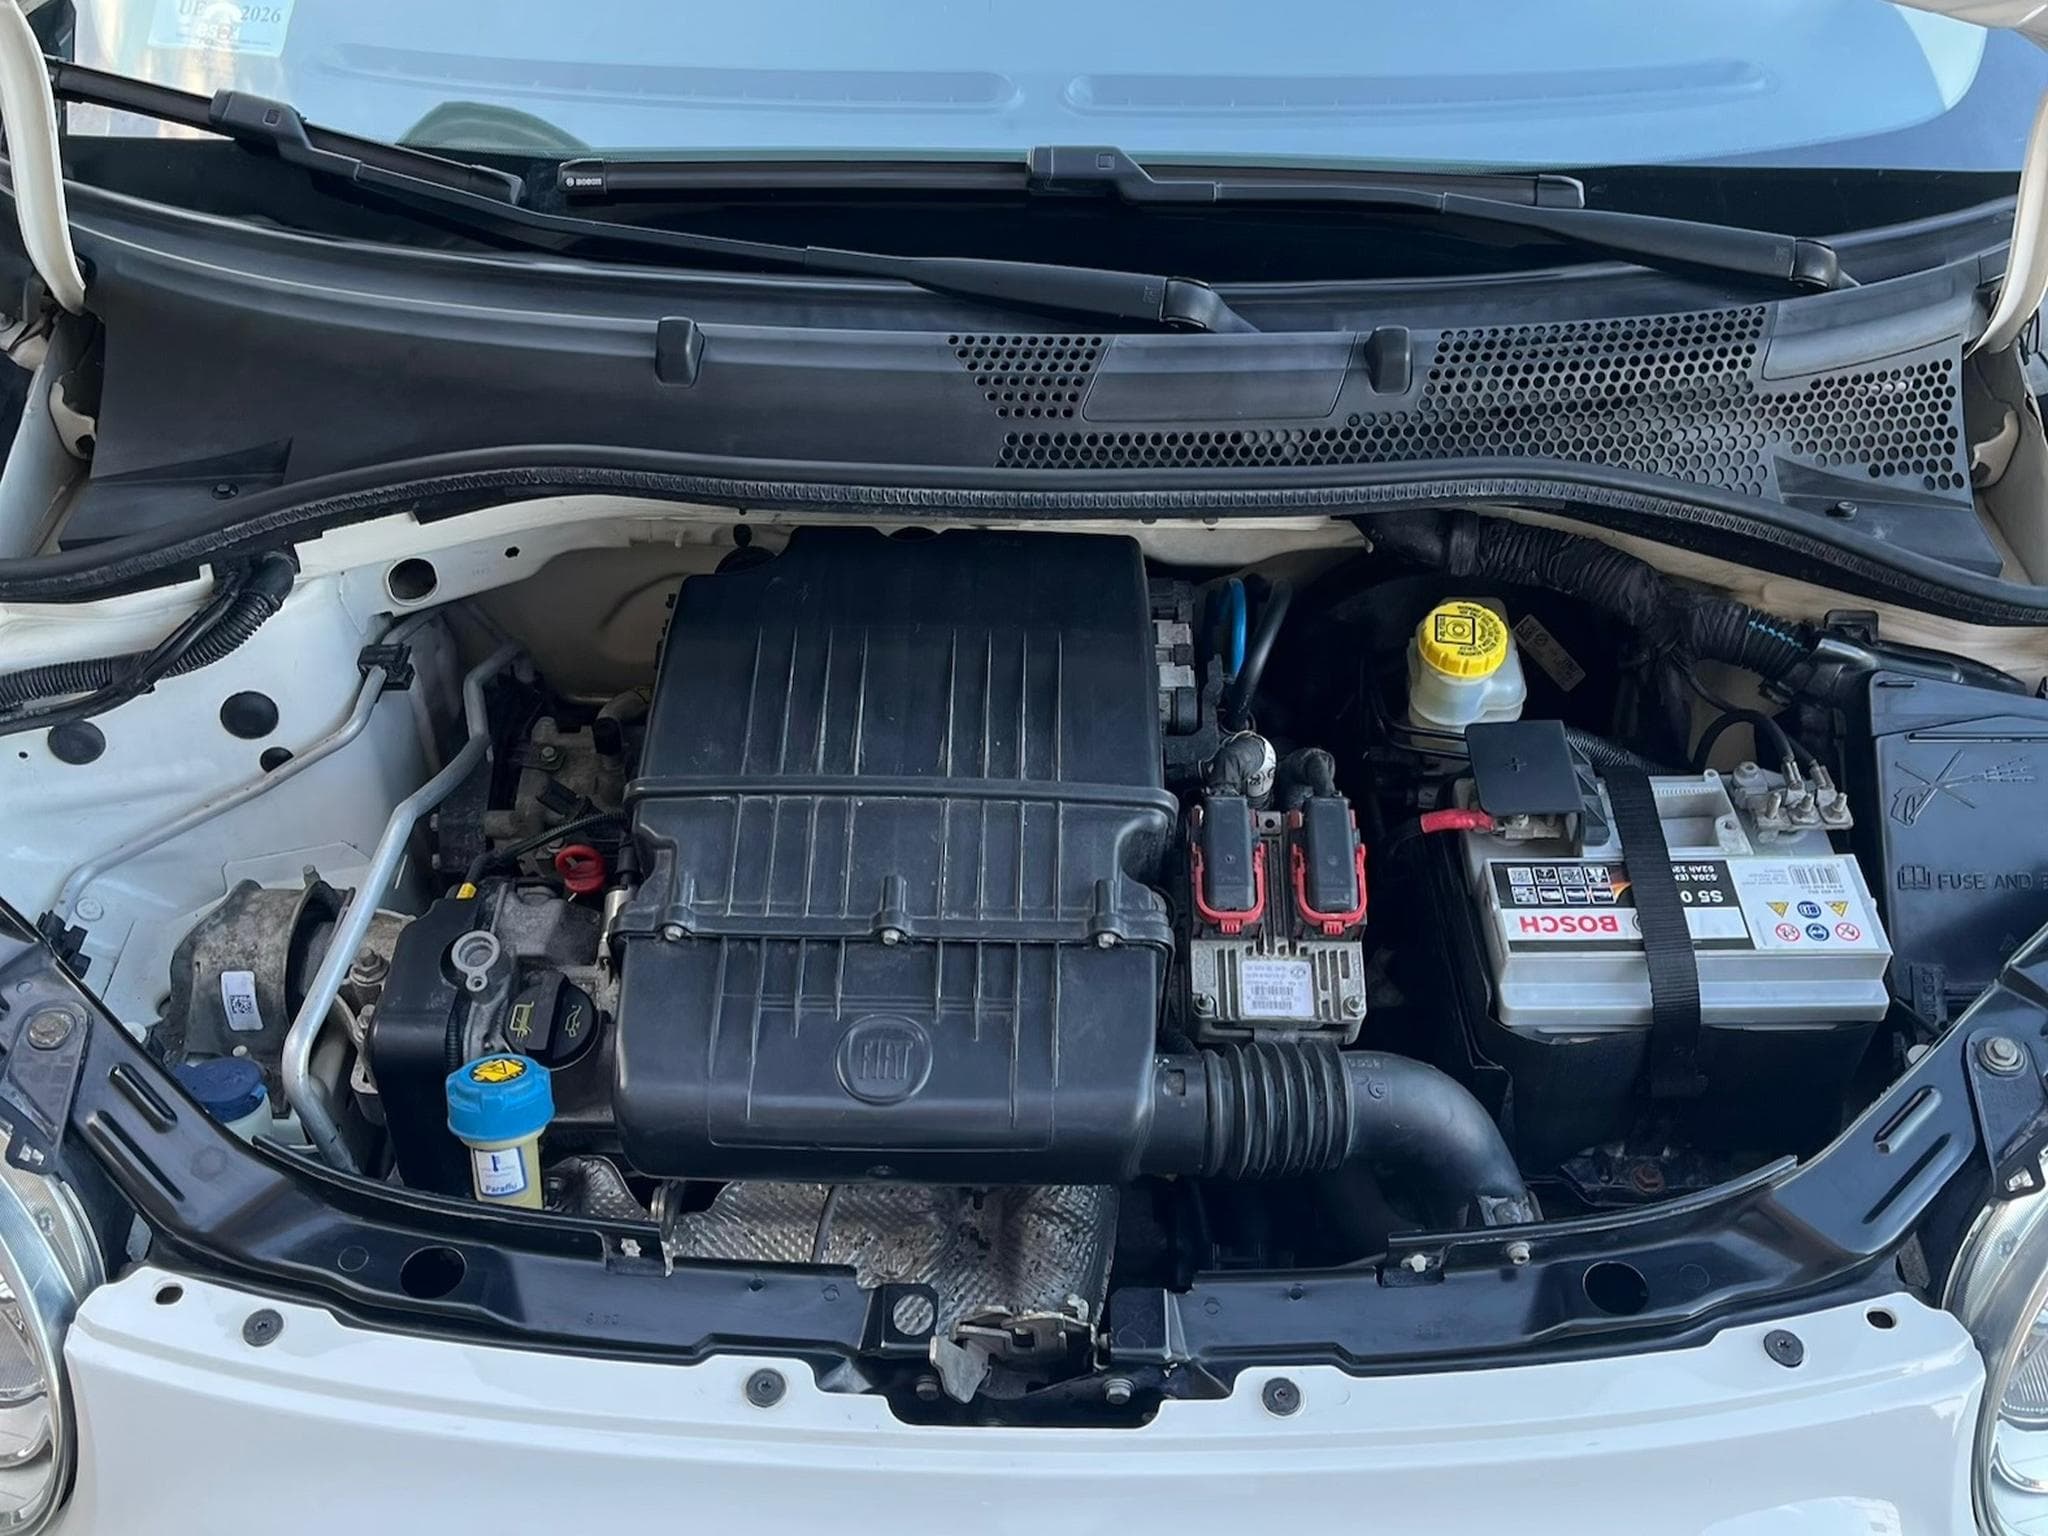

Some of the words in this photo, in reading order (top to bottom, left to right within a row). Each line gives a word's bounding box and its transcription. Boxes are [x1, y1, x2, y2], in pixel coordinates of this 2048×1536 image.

[241, 6, 281, 23] 2026
[1688, 865, 1715, 873] 52Ah
[1690, 873, 1719, 881] 520A
[1938, 873, 1986, 889] FUSE
[1994, 873, 2032, 889] AND
[1698, 890, 1724, 903] S5
[1520, 916, 1619, 933] BOSCH
[859, 1041, 914, 1080] FIAT
